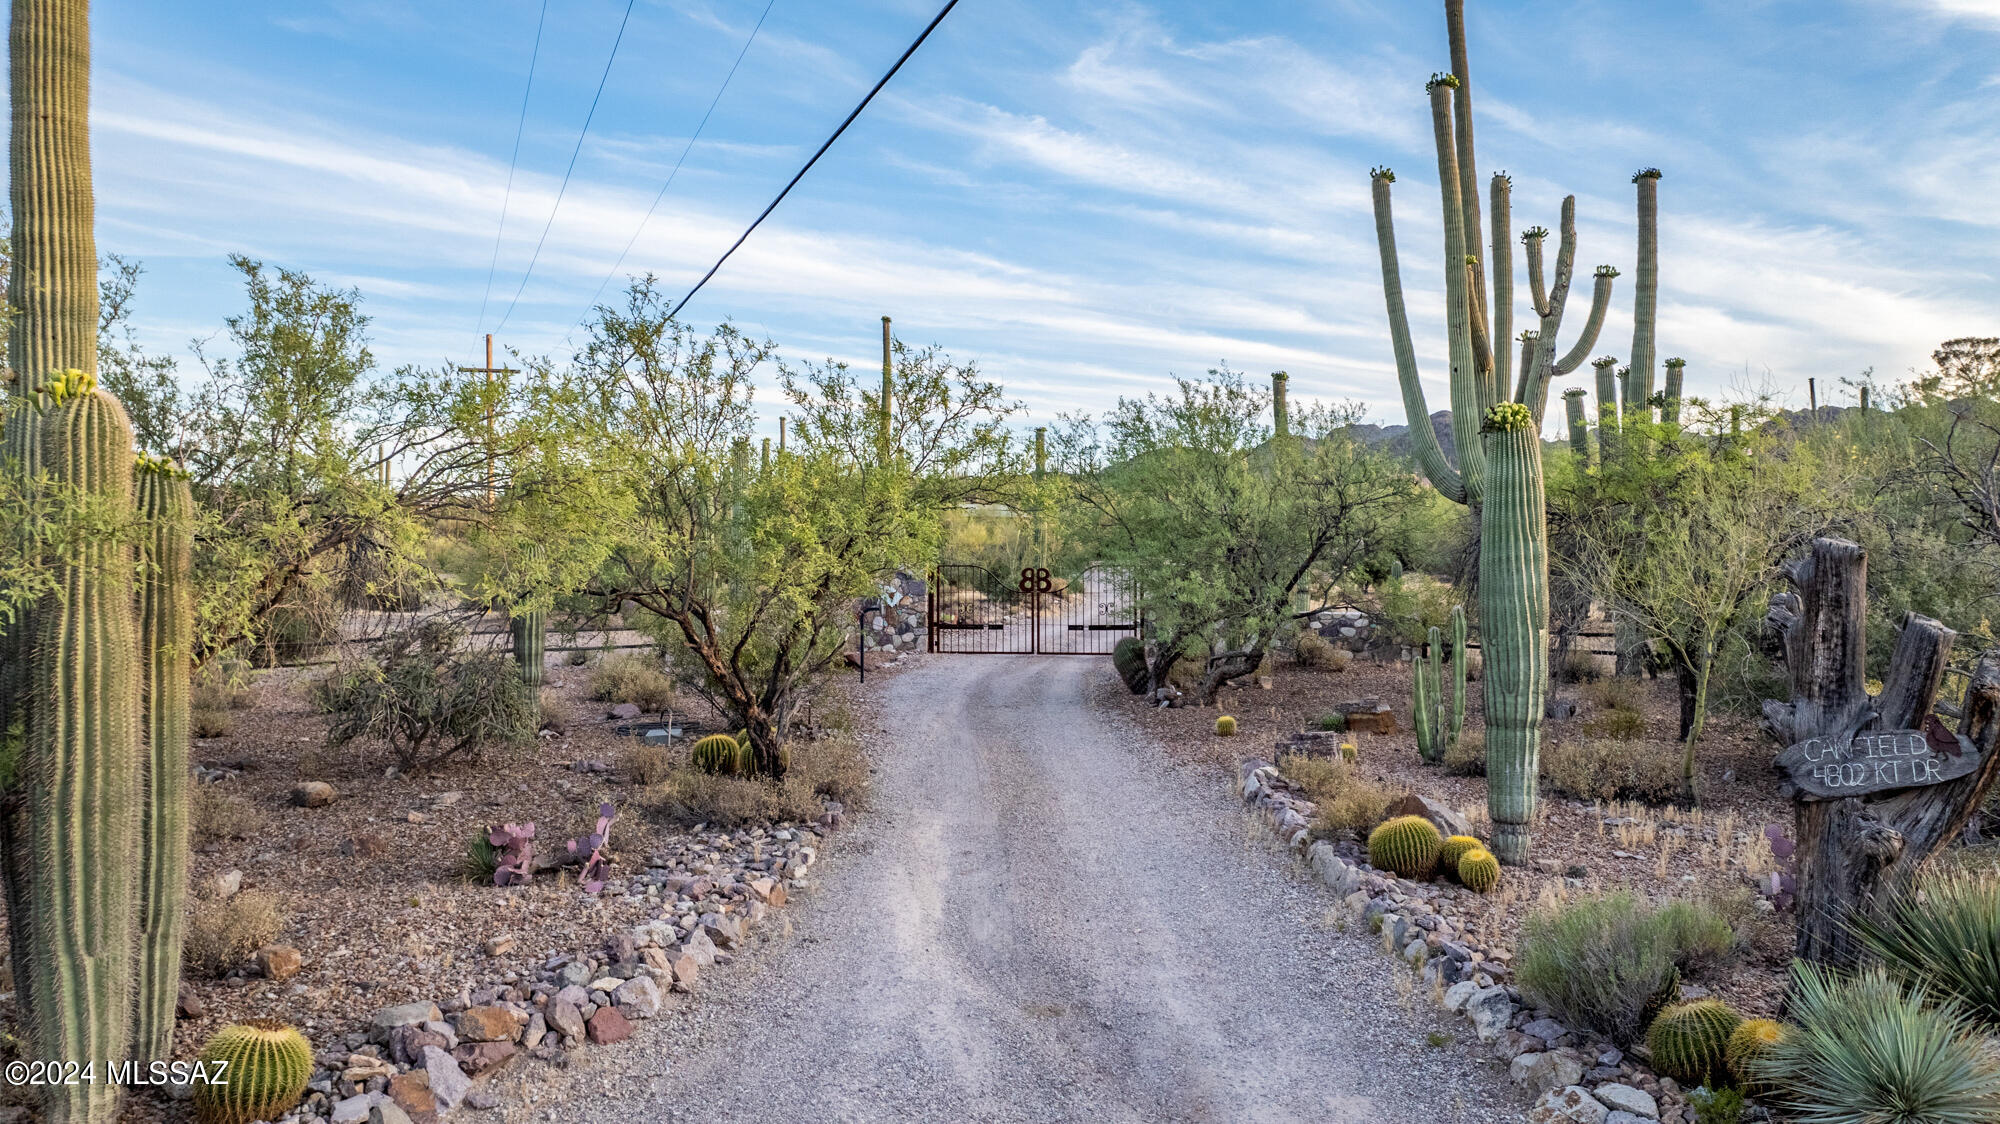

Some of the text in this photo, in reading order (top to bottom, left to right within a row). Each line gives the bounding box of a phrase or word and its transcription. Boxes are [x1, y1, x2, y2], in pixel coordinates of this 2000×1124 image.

[1804, 735, 1927, 762] CANFIELD
[1813, 759, 1944, 787] 4802 KT DR
